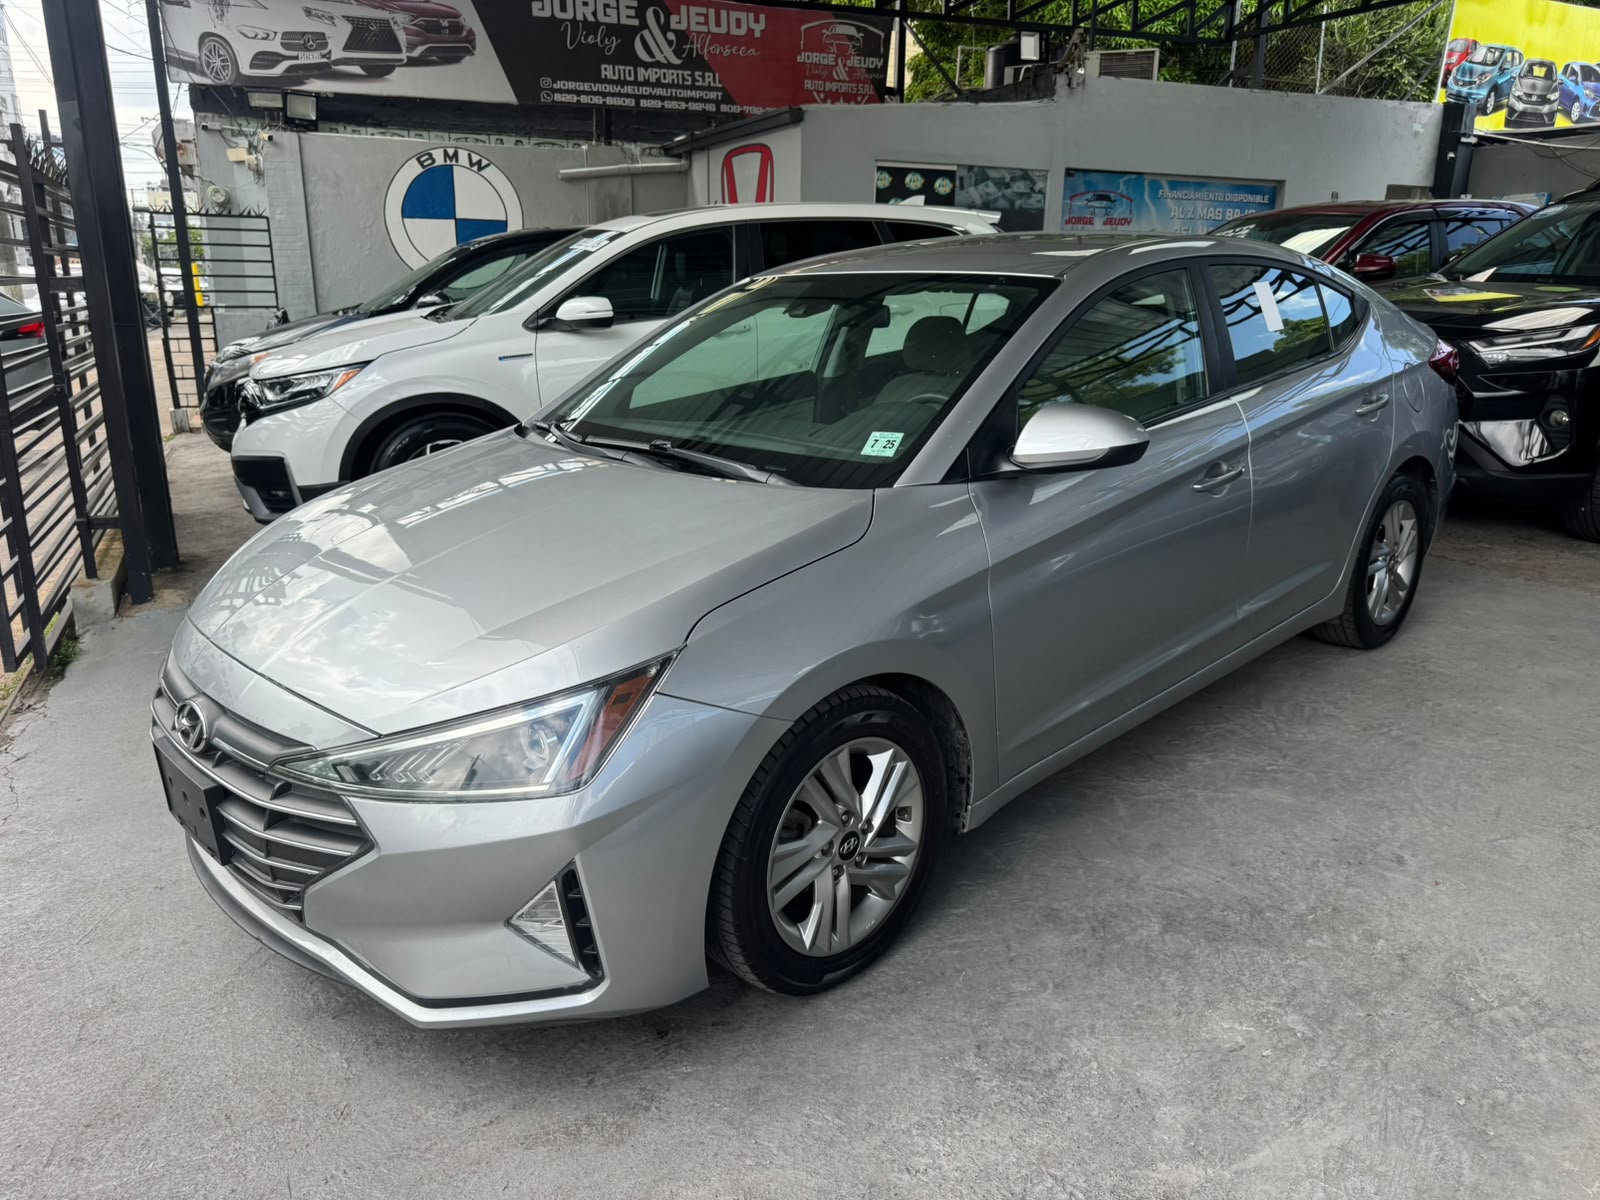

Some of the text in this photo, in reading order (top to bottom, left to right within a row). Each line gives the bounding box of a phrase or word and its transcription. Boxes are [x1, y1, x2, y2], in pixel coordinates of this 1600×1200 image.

[532, 0, 766, 65] JORGE & JEUDY
[561, 22, 761, 60] Violy Alfonseca
[797, 51, 836, 66] JORGE
[847, 55, 884, 70] JEUDY
[600, 64, 635, 81] AUTO
[637, 66, 692, 85] IMPORTS
[552, 80, 723, 100] JORGEVIOLYJEUDYAUTOIMPORT
[804, 80, 824, 91] AUTO
[825, 81, 857, 94] IMPORTS
[416, 149, 491, 172] BMW
[1159, 189, 1270, 204] FINANCIAMIENTO DISPONIBLE
[1065, 216, 1133, 227] JORGE JEUDY
[1170, 206, 1185, 220] AL
[1197, 207, 1223, 220] MAS
[870, 438, 897, 449] 7 25
